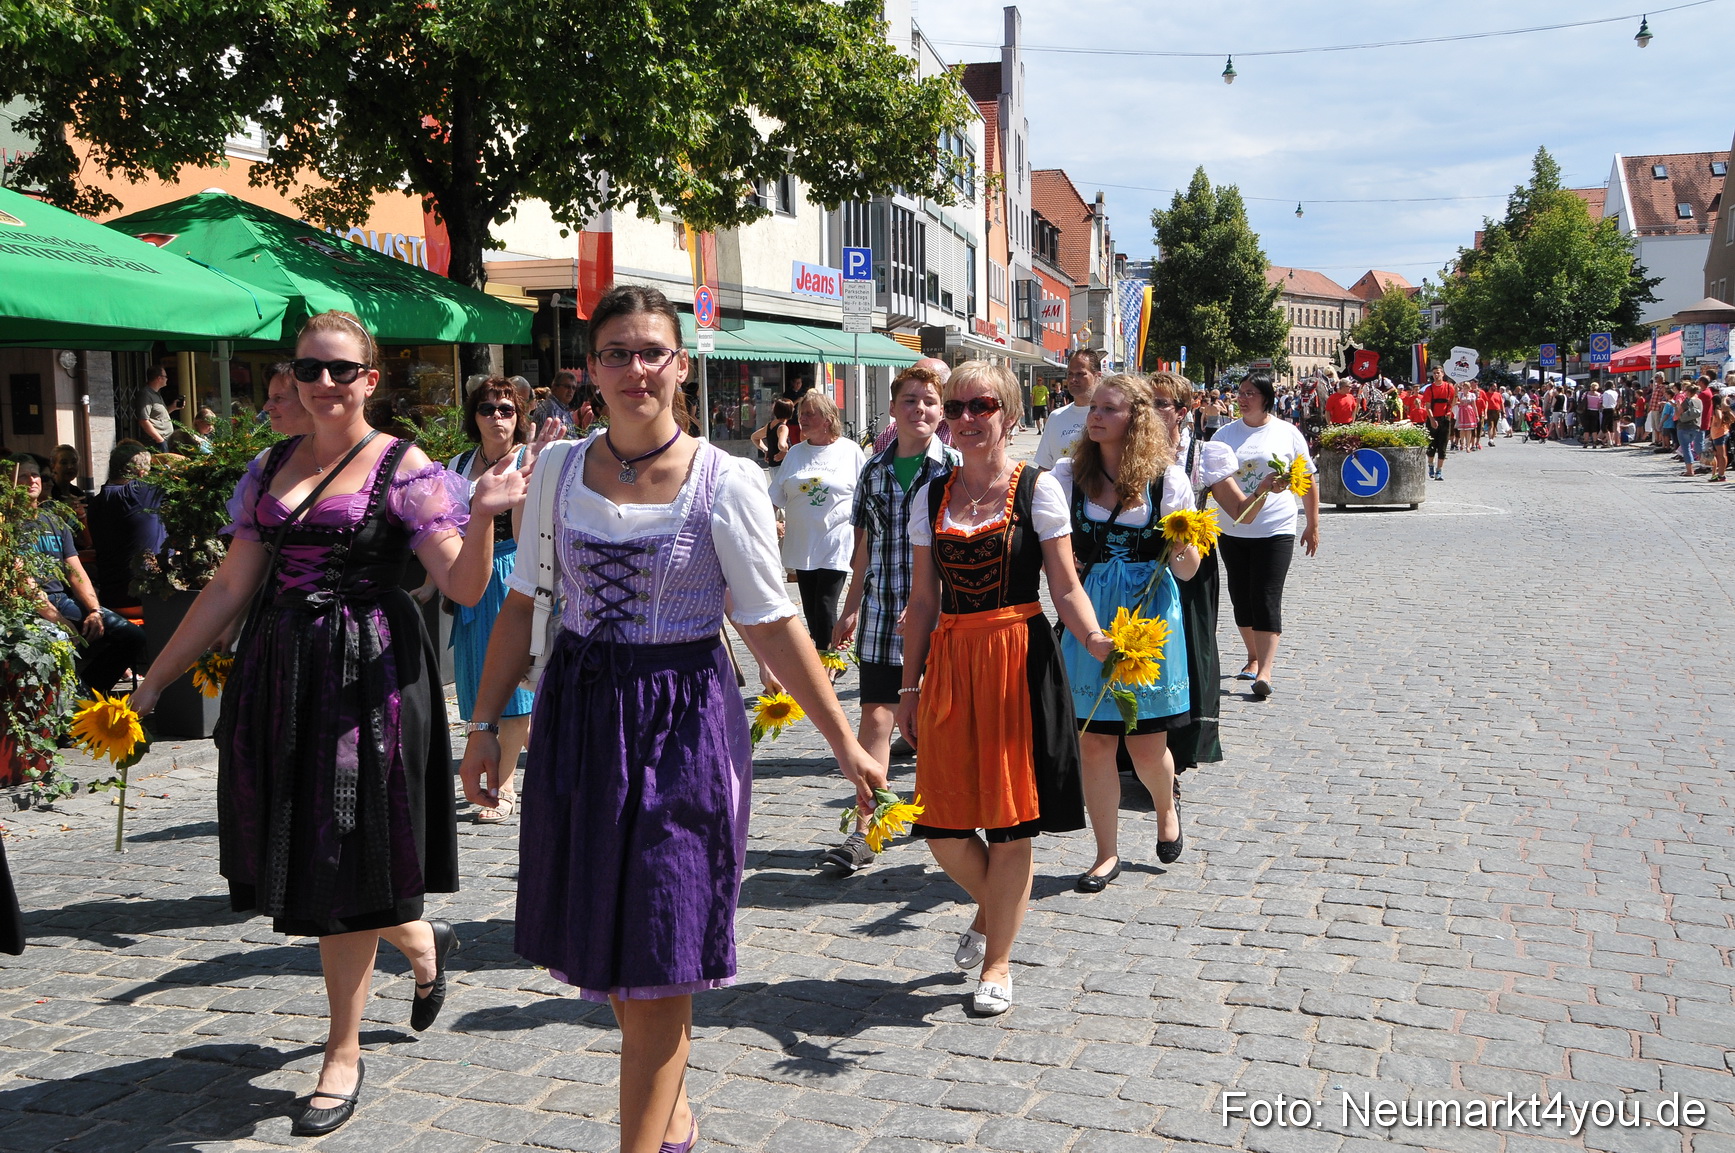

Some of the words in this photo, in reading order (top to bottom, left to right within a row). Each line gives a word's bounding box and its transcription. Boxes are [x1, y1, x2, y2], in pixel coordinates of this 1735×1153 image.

[0, 243, 162, 275] ammsbräu
[849, 251, 865, 276] P
[796, 265, 835, 295] Jeans
[1041, 304, 1061, 318] H&M
